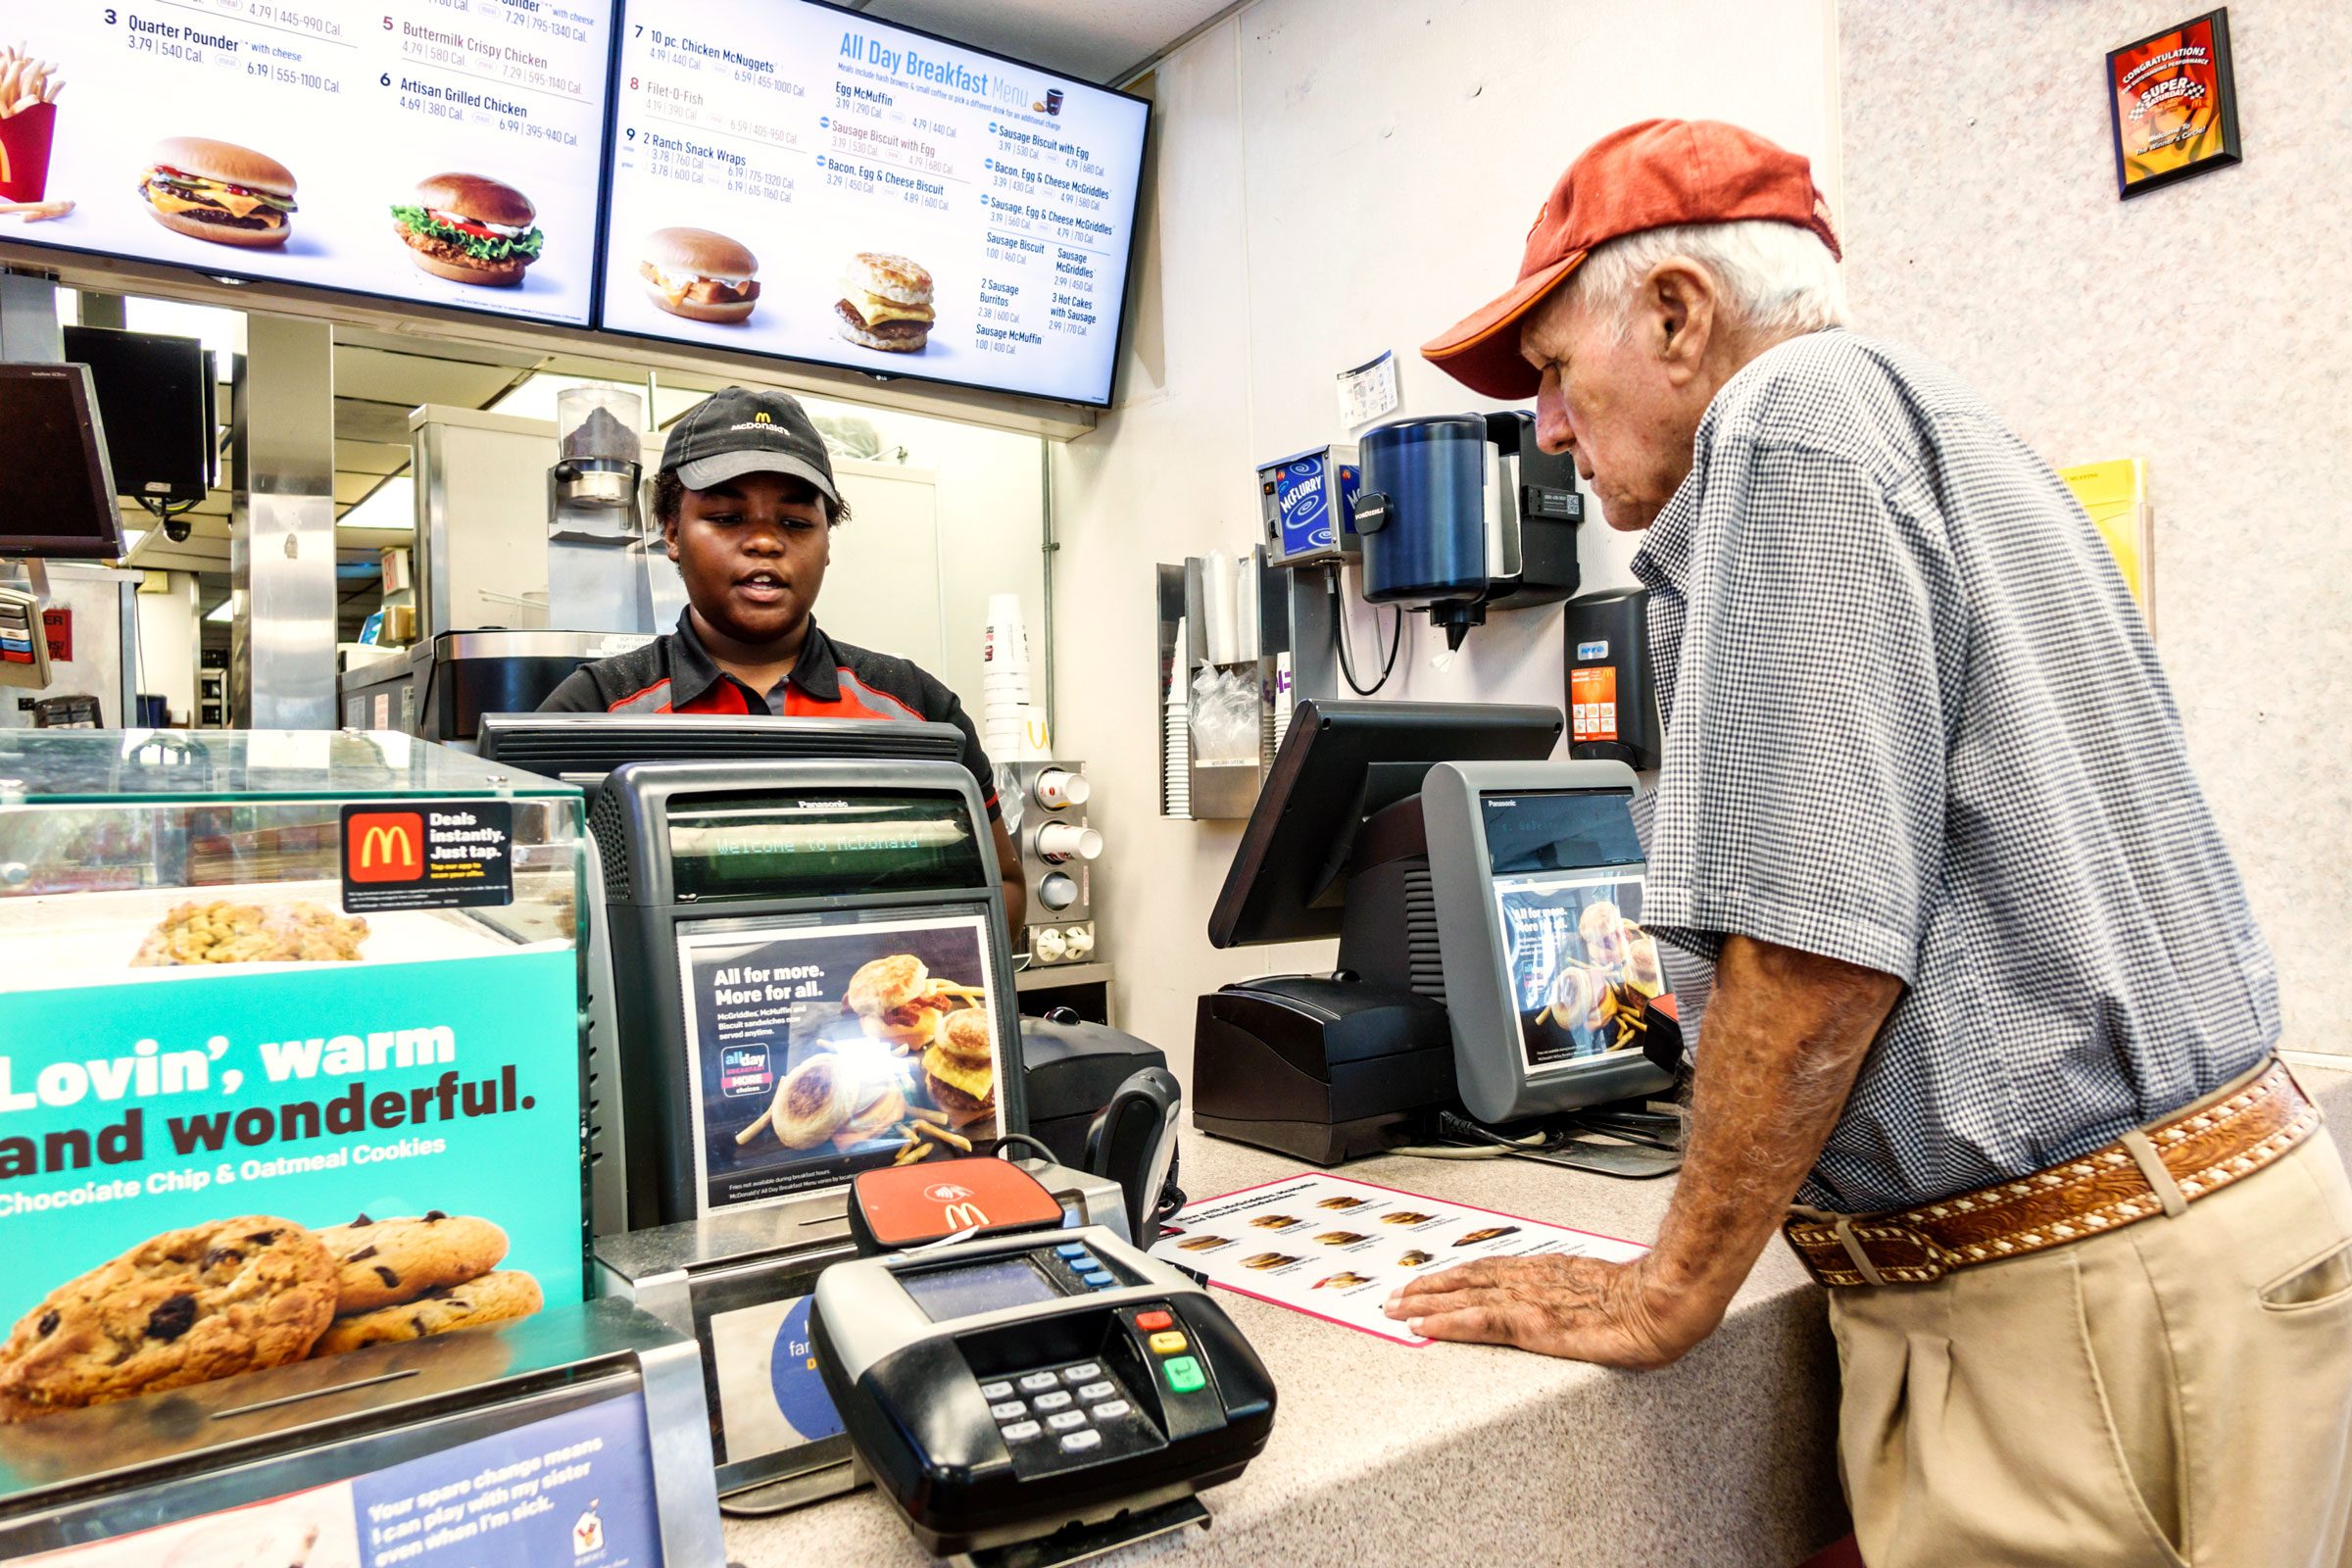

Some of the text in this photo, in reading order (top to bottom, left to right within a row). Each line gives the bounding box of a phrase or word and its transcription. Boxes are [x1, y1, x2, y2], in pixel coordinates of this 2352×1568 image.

[104, 9, 303, 62] 3 Quarter Pounder with cheese
[382, 16, 548, 70] 5 Buttermilk Crispy Chicken
[634, 24, 774, 74] 7 10 pc. Chicken McNuggets
[128, 34, 341, 95] 3.79 540 Cal. 6.19 555-1100 Cal.
[840, 31, 1029, 108] All Day Breakfast Menu
[2122, 46, 2206, 83] CONGRATULATIONS
[379, 72, 527, 119] 6 Artisan Grilled Chicken
[629, 76, 704, 106] 8 Filet-O-Fish
[835, 81, 894, 107] Egg McMuffin
[2140, 76, 2188, 100] SUPER
[2145, 87, 2186, 109] SATURDAY
[832, 120, 935, 159] Sausage Biscuit with Egg
[999, 125, 1090, 162] Sausage Biscuit with Egg
[2148, 122, 2191, 143] Welcome To
[626, 127, 747, 167] 9 2 Ranch Snack Wraps
[858, 166, 874, 182] Egg
[876, 170, 883, 181] &
[885, 172, 915, 189] Cheese
[916, 179, 944, 196] Biscuit
[981, 277, 1019, 296] 2 Sausage
[980, 292, 1009, 308] Burritos
[976, 323, 1042, 345] Sausage McMuffin
[730, 421, 791, 437] McDonald's
[798, 800, 849, 808] Panasonic
[1488, 799, 1517, 808] Panasonic
[429, 812, 477, 827] Deals
[429, 828, 506, 844] instantly.
[716, 838, 796, 856] Welcome
[808, 838, 827, 852] to
[429, 845, 503, 860] Just tap.
[713, 964, 825, 986] All for more.
[714, 980, 824, 1005] More for all.
[792, 1004, 807, 1013] and
[718, 1021, 744, 1031] Biscuit
[744, 1017, 785, 1028] sandwiches
[718, 1028, 774, 1040] served anytime.
[0, 1024, 457, 1112] Lovin', warm
[732, 1073, 762, 1087] MORE
[736, 1085, 760, 1094] choices
[0, 1063, 537, 1177] and wonderful.
[0, 1135, 447, 1217] Chocolate Chip & Oatmeal Cookies
[368, 1437, 604, 1523] Your spare change means
[371, 1462, 592, 1545] I can play with my sister
[374, 1494, 556, 1567] even when I'm sick.
